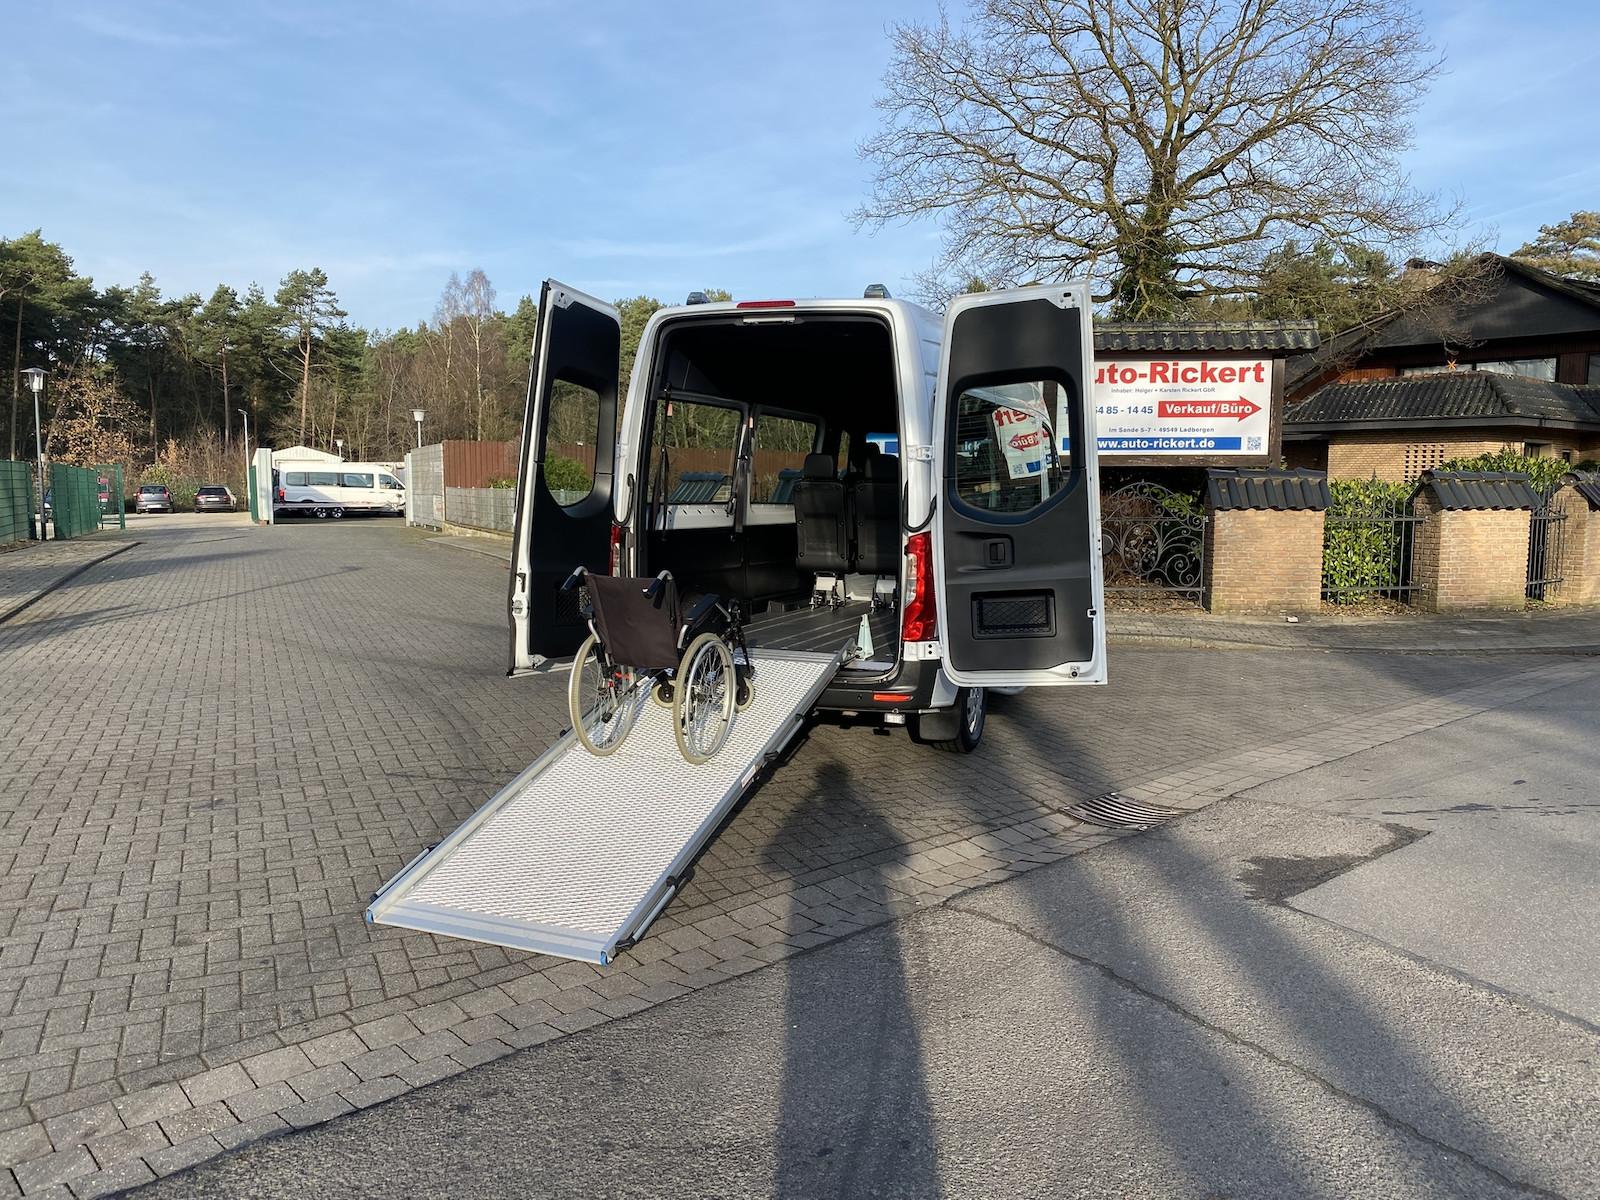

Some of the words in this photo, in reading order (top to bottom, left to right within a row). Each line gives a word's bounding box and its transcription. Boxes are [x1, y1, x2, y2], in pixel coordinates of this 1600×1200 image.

[1094, 361, 1265, 385] uto-Rickert
[1106, 406, 1119, 415] 85
[1127, 406, 1139, 415] 14
[1140, 406, 1154, 415] 45
[1165, 403, 1253, 415] Verkauf/Büro
[1097, 438, 1216, 449] ww.auto-rickert.de
